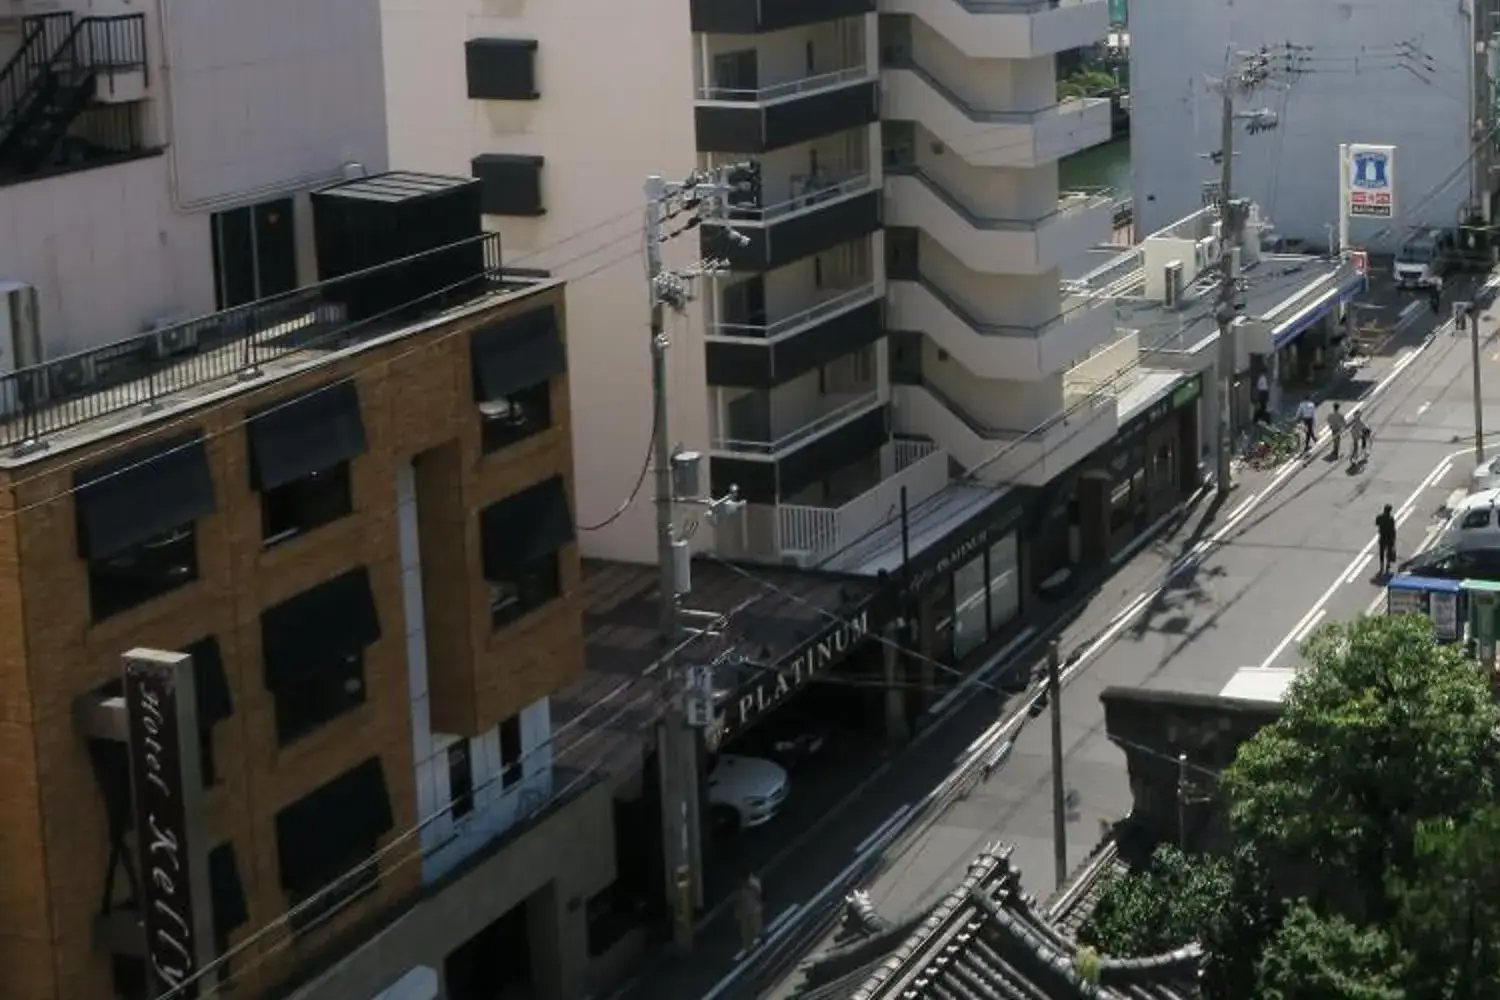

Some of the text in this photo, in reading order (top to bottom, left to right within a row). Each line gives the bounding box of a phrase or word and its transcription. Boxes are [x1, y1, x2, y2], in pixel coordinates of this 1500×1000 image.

[738, 610, 870, 724] PLATINUM
[140, 681, 191, 993] Hotel Kelly
